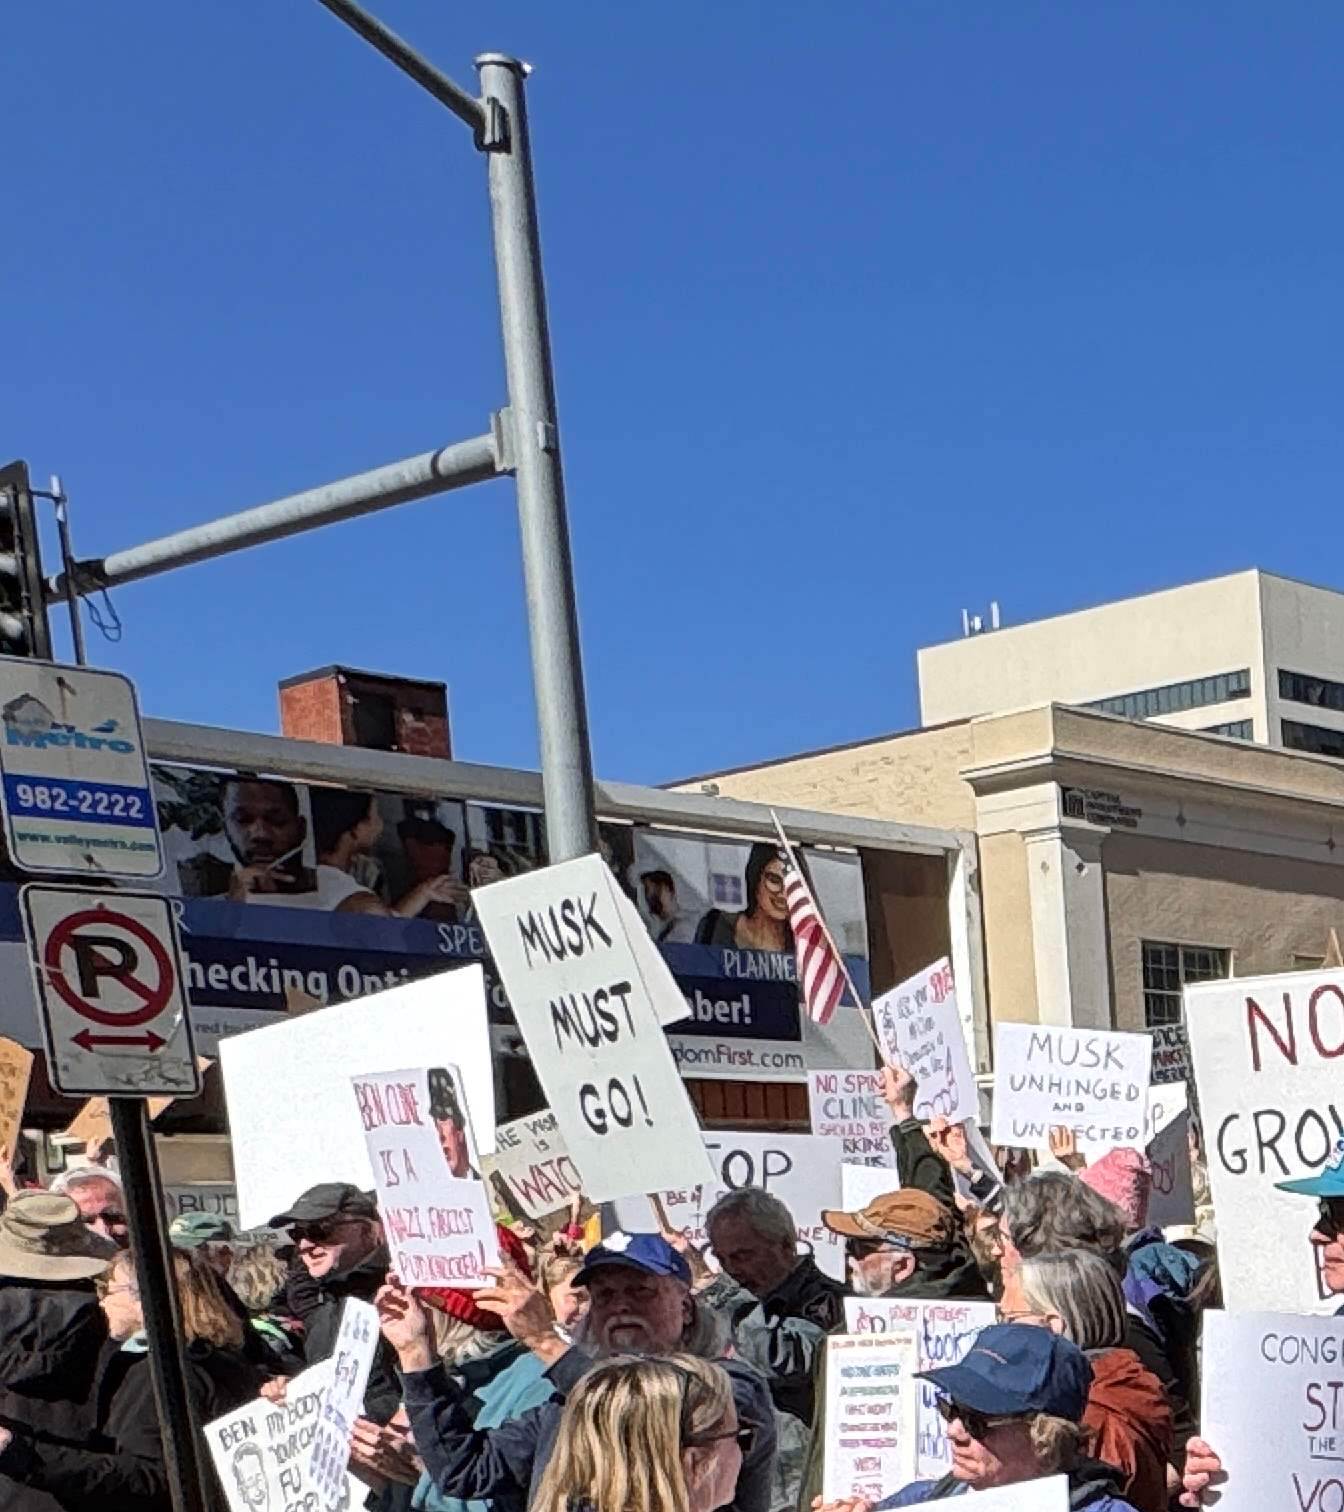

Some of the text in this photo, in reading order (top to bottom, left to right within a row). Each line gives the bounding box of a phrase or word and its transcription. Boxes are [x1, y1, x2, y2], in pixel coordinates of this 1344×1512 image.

[16, 784, 144, 819] 982-2222
[438, 924, 484, 955] SPE
[517, 892, 612, 968] MUSK
[181, 950, 328, 1002] hecking
[722, 950, 799, 981] PLANNE
[551, 981, 638, 1054] MUST
[689, 989, 752, 1024] ber!
[673, 1042, 804, 1068] domFirst.com
[1026, 1032, 1125, 1071] MUSK
[815, 1074, 887, 1094] NO SPIN
[1009, 1073, 1140, 1102] UNHINGED
[579, 1074, 654, 1136] GO!
[822, 1096, 884, 1120] CLINE
[1052, 1101, 1085, 1113] AND
[1012, 1119, 1140, 1142] UNECTED
[508, 1154, 584, 1211] WATC
[218, 1416, 258, 1450] BEN
[1307, 1435, 1337, 1455] THE
